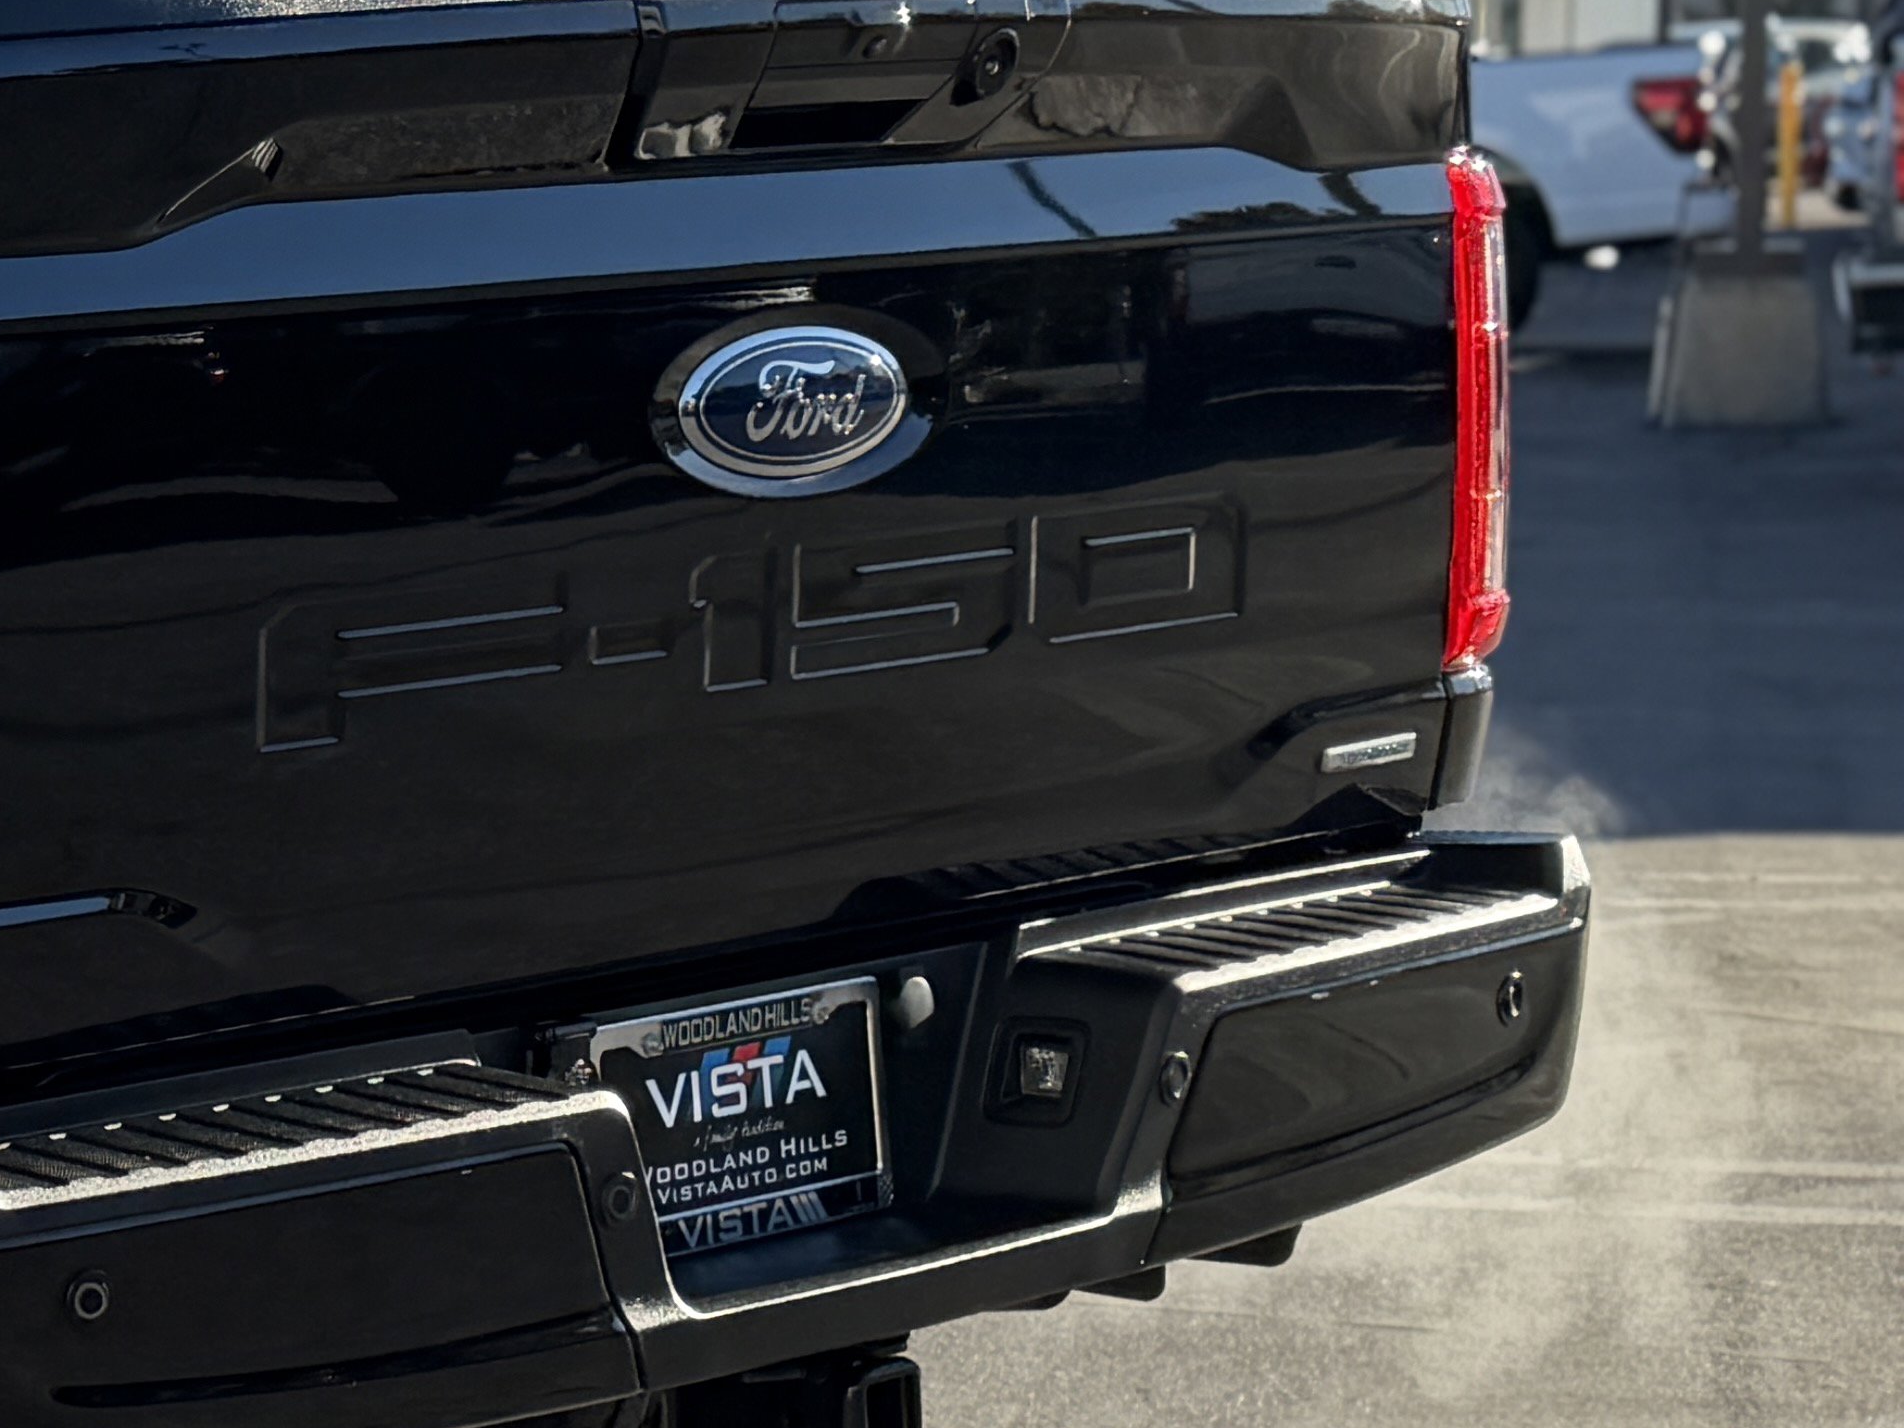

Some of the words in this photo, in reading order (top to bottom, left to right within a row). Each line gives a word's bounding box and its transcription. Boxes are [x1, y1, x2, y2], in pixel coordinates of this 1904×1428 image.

[746, 359, 865, 442] Ford
[256, 490, 1246, 754] F-150
[662, 1006, 762, 1048] WOODLAND
[764, 997, 812, 1029] HILLS
[645, 1047, 826, 1129] VISTA
[780, 1129, 848, 1158] HILLS
